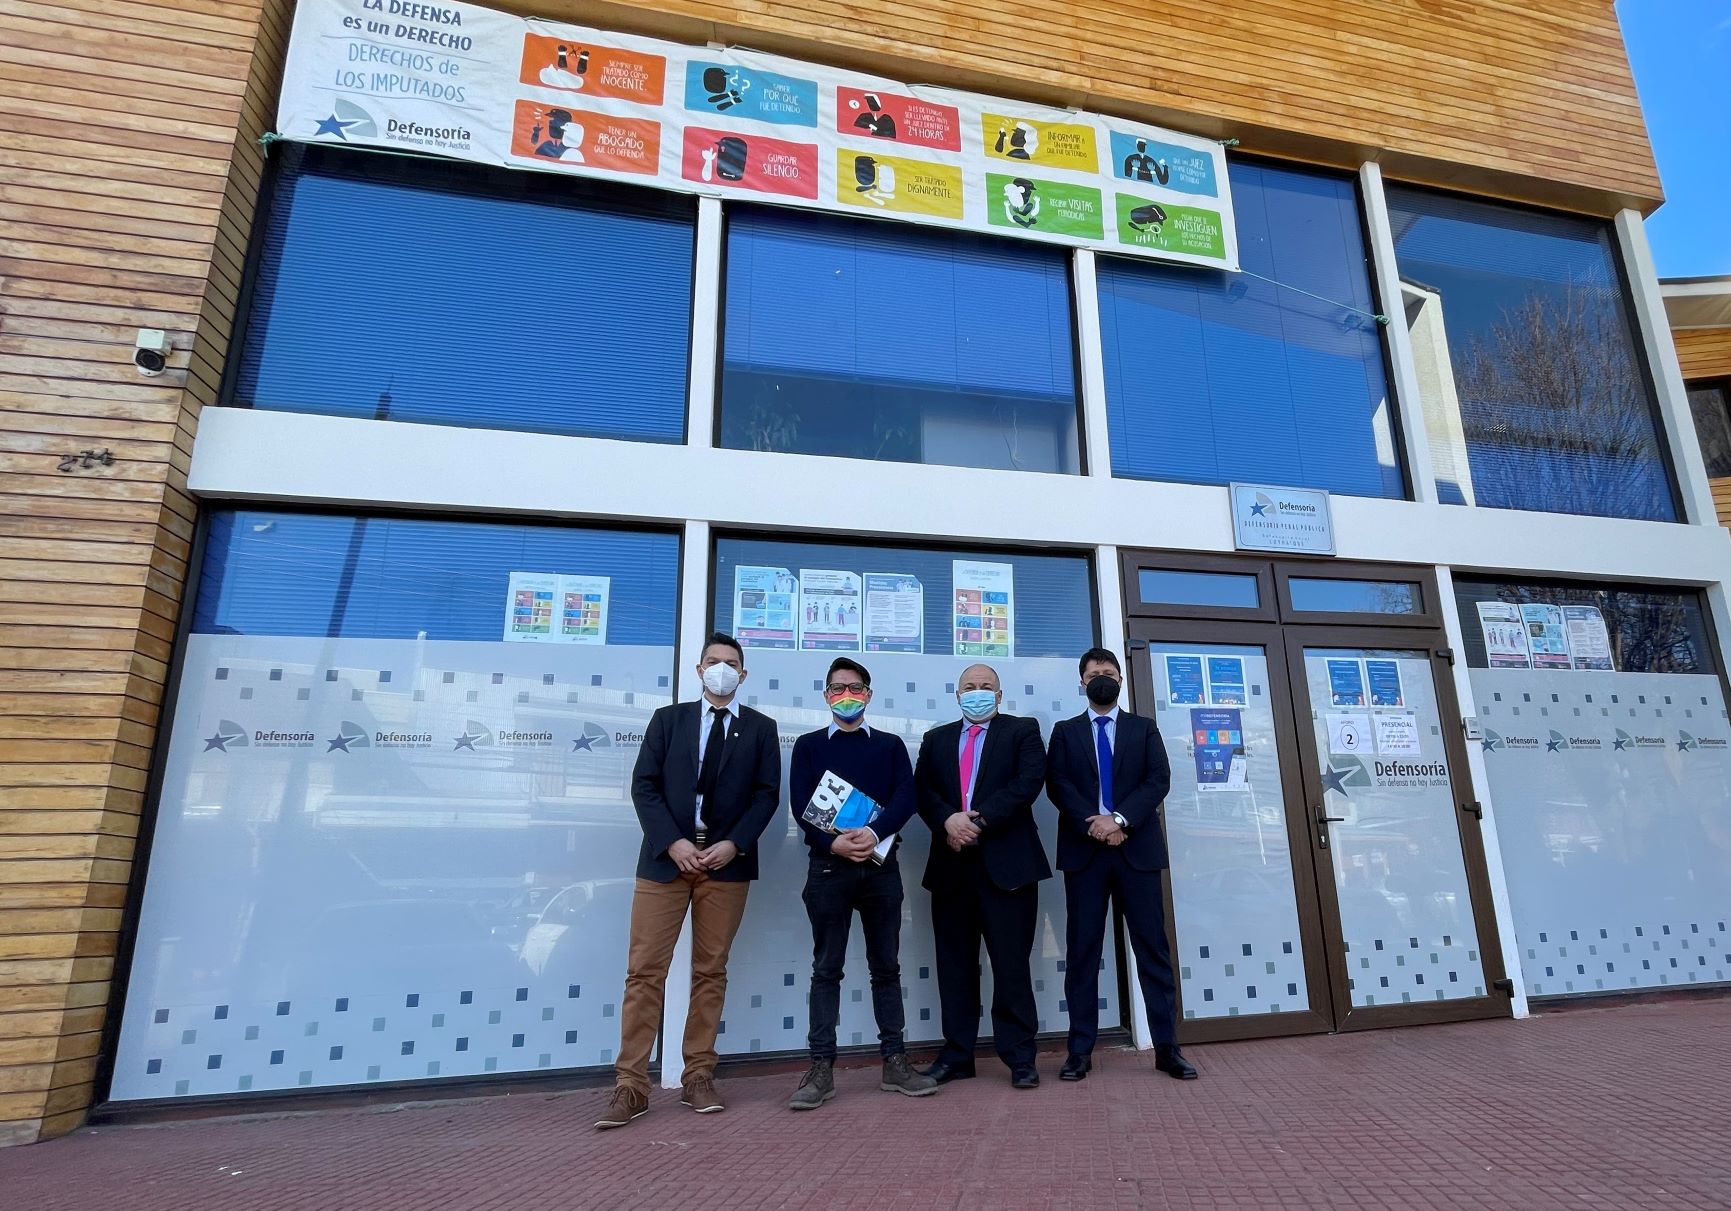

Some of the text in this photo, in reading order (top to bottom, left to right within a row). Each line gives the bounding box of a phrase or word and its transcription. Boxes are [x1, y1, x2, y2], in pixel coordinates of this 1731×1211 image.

[363, 0, 461, 26] LA DEFENSA
[343, 15, 472, 51] es un DERECHO
[349, 43, 459, 76] DERECHOS de
[336, 69, 466, 103] LOS IMPUTADOS
[764, 88, 780, 101] POR
[387, 119, 471, 141] Defensoría
[919, 128, 945, 141] HORAS
[598, 133, 644, 150] ABOGADO
[907, 183, 951, 199] DIGNAMENTE
[1174, 219, 1218, 236] INVESTIGUEN
[1279, 501, 1316, 513] Defensoría
[255, 730, 314, 741] Defensoría
[375, 731, 432, 742] Defensoría
[499, 730, 552, 741] Defensoría
[1346, 733, 1354, 745] 2
[1375, 761, 1446, 776] Defensoría
